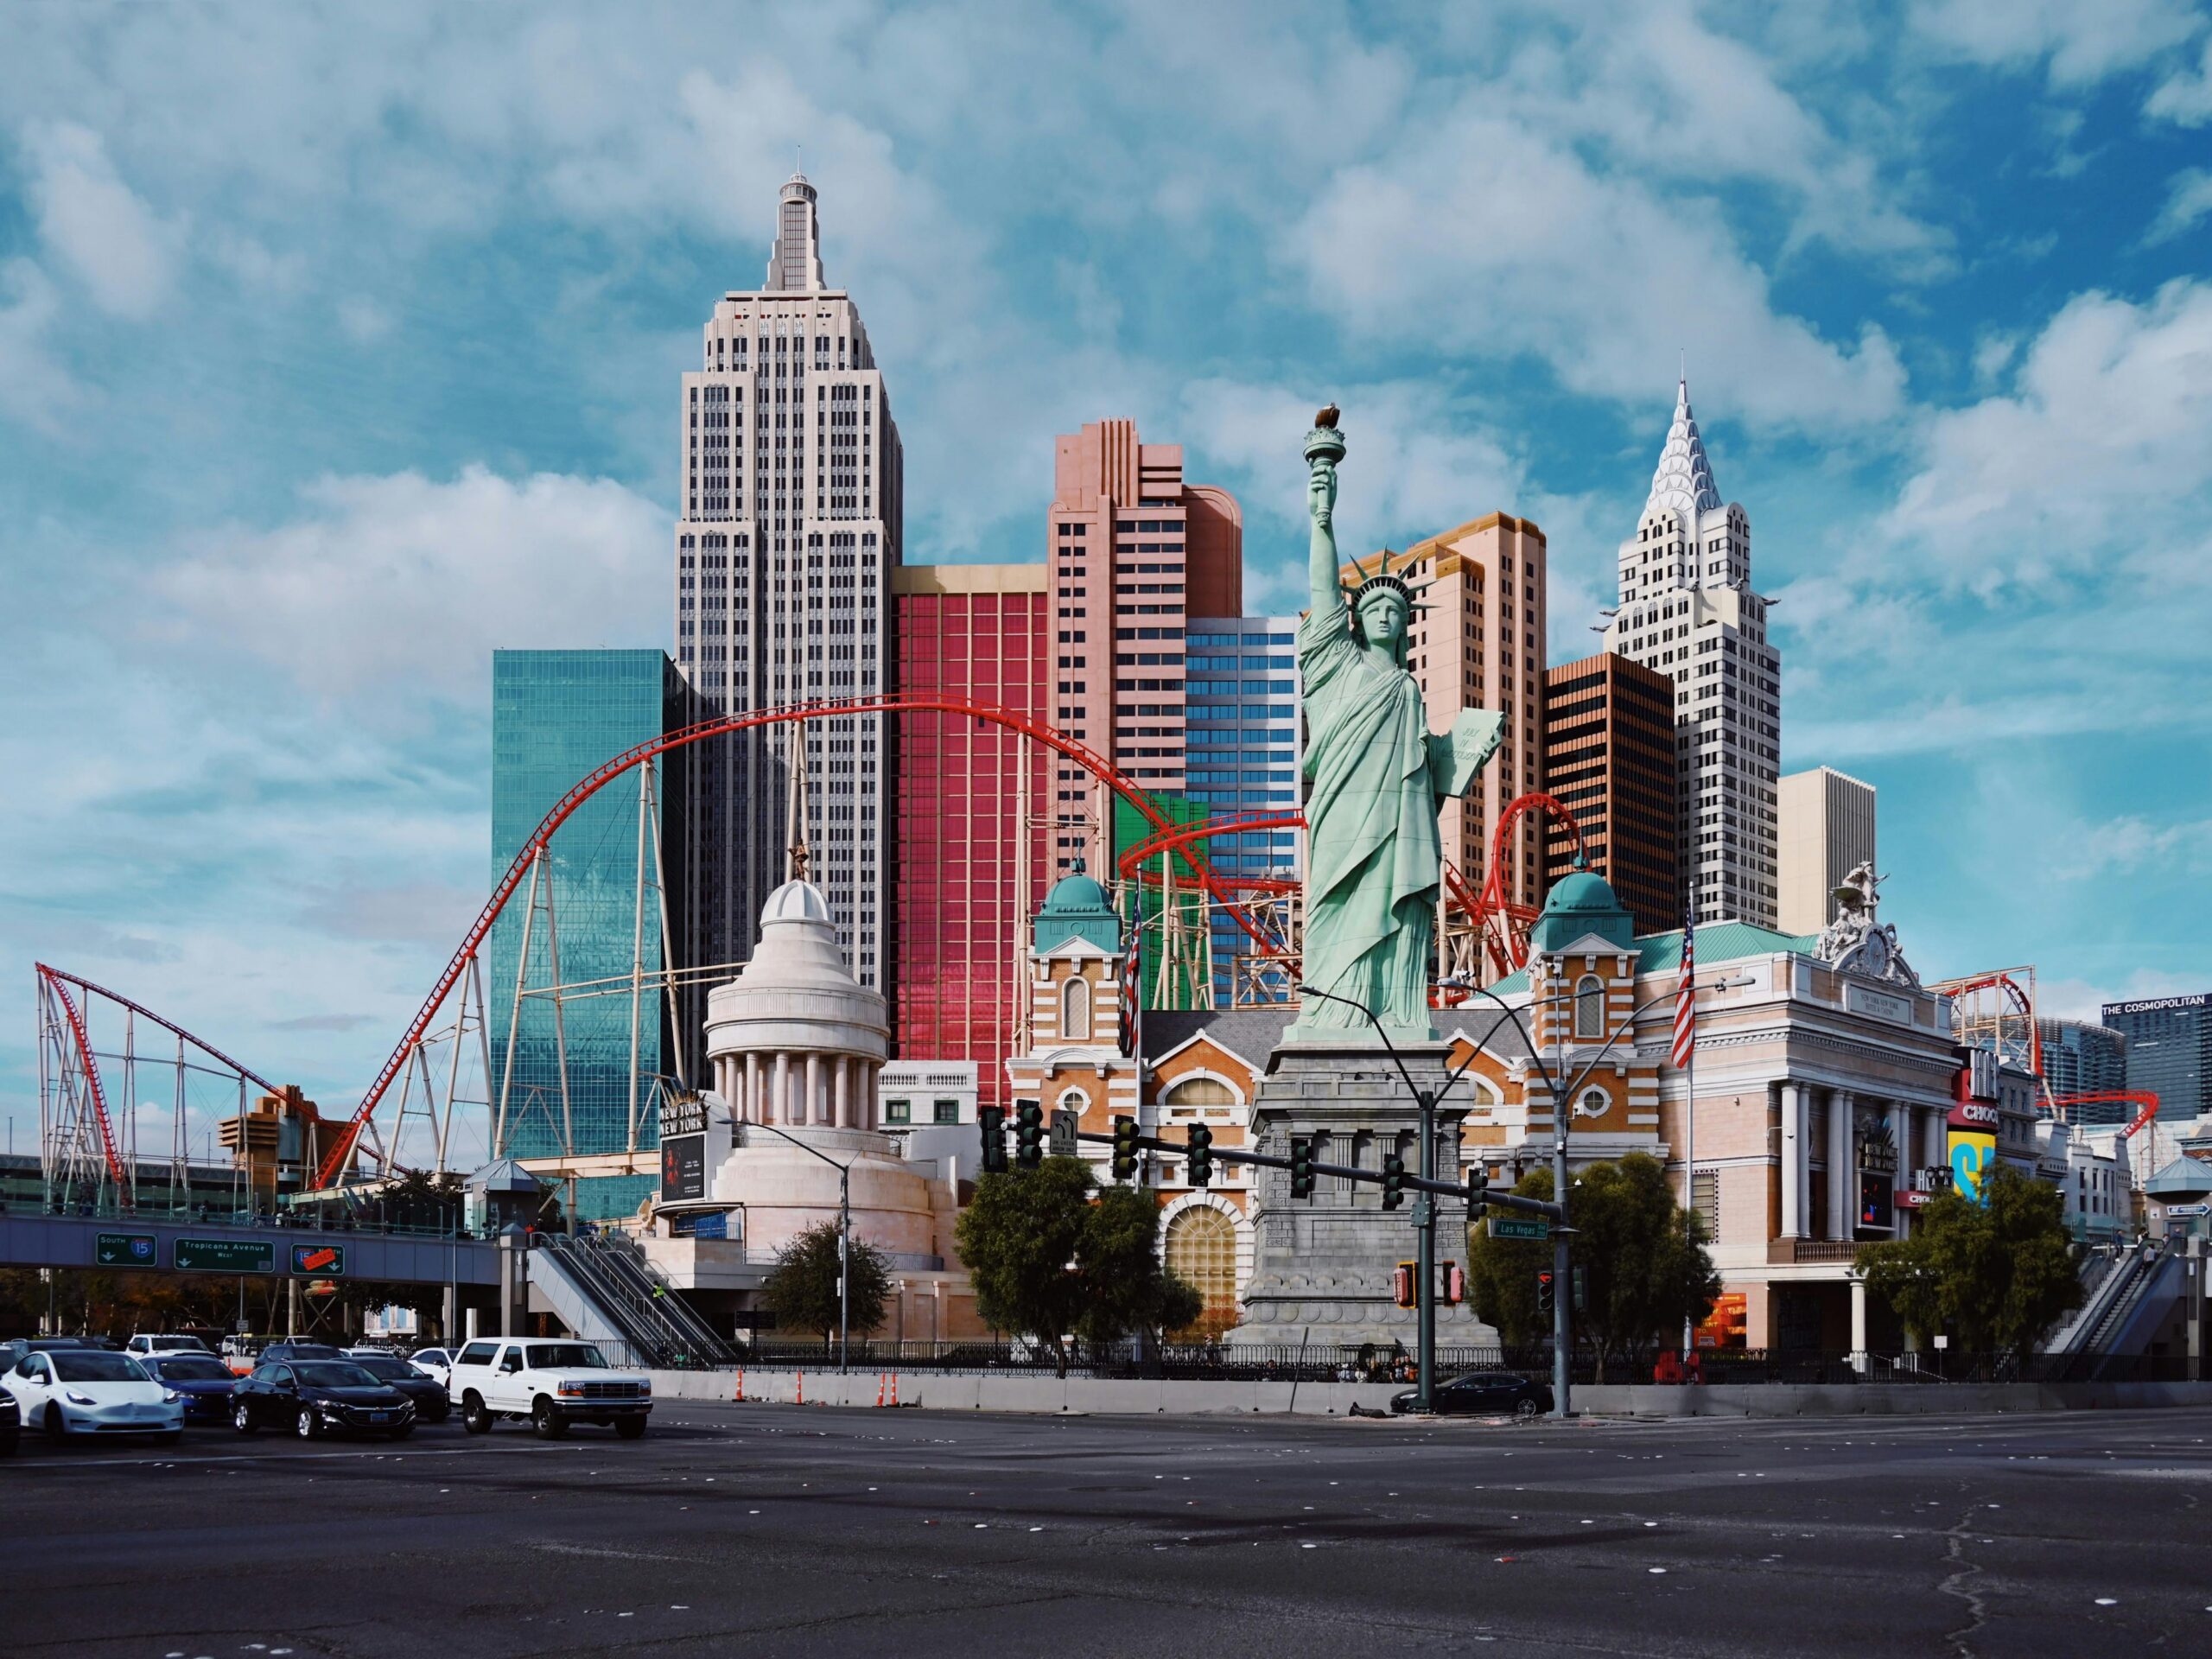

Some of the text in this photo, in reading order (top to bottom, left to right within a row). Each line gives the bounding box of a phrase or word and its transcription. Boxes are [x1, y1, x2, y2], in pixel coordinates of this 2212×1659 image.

[2102, 995, 2205, 1015] THE COSMOPOLITAN
[659, 1103, 703, 1121] NEW YORK
[659, 1117, 703, 1135] NEW YORK
[1501, 1224, 1514, 1233] Las
[1516, 1224, 1535, 1236] Vegas
[137, 1243, 149, 1254] 15
[184, 1242, 229, 1250] Tropicana
